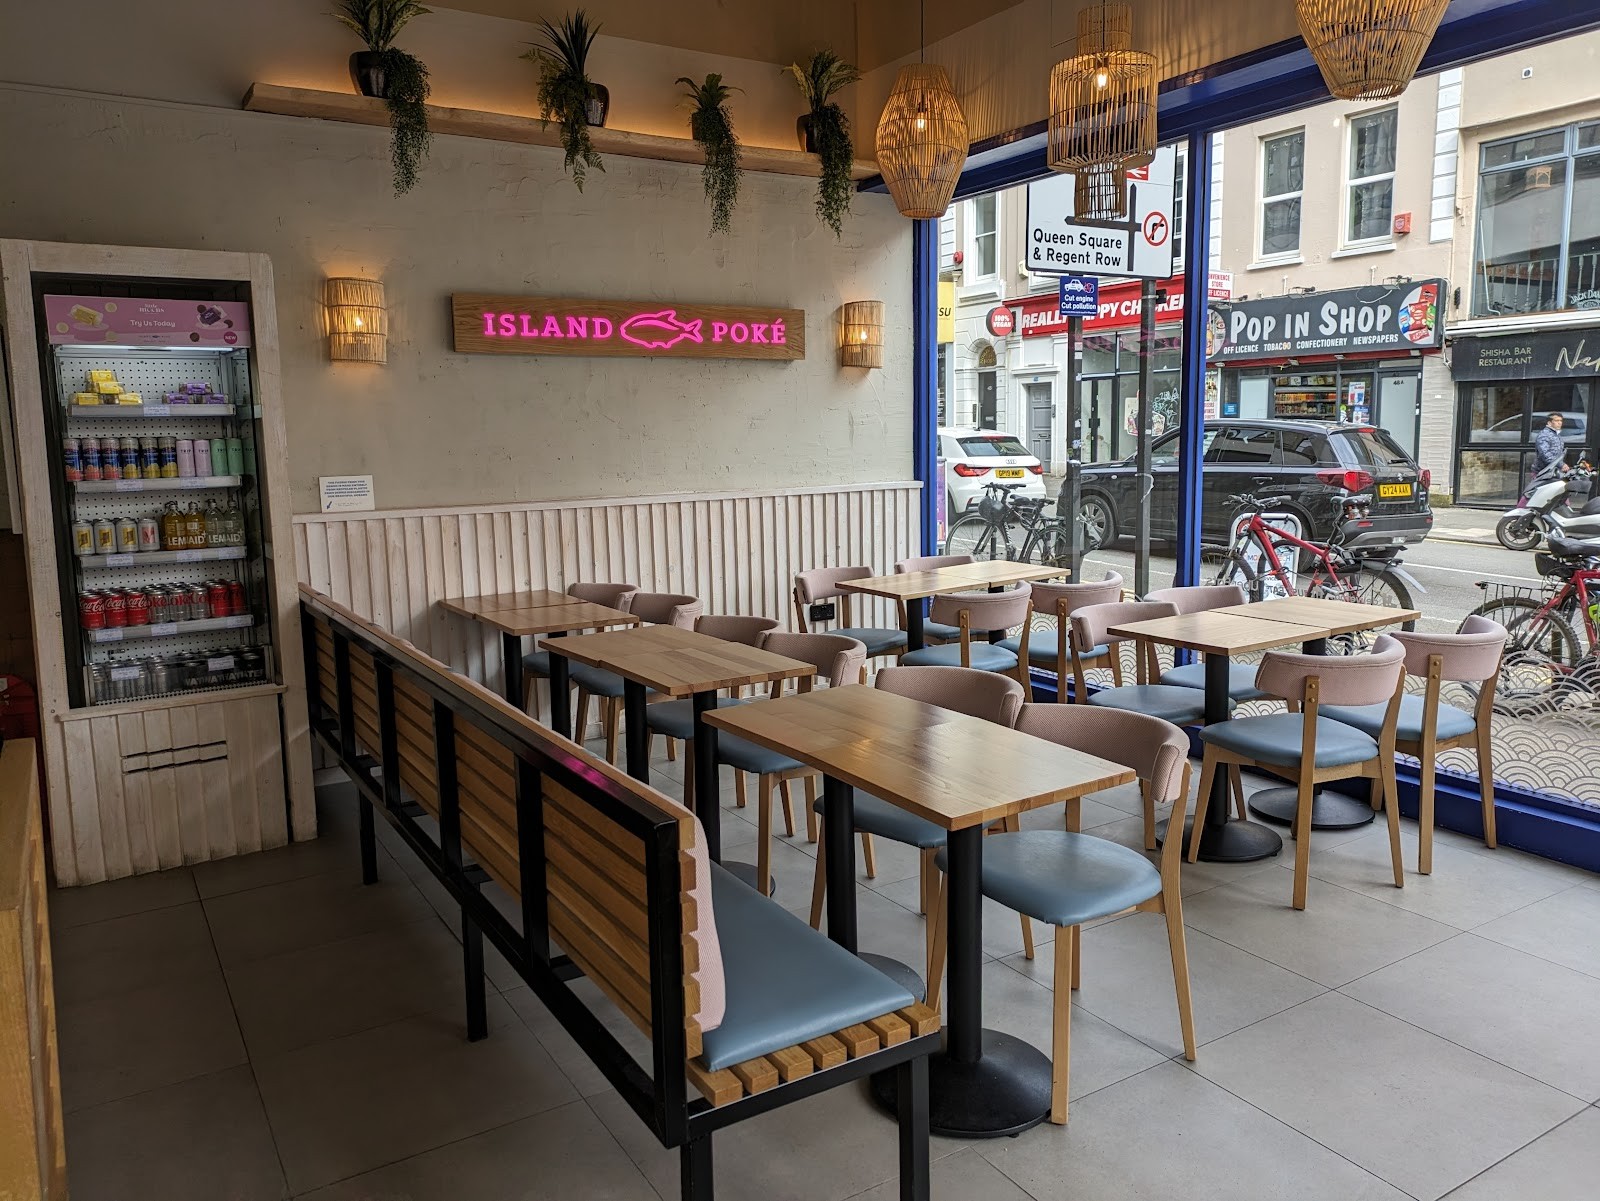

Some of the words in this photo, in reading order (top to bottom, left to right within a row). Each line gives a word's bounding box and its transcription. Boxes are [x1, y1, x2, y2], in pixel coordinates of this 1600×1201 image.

[1033, 228, 1074, 245] Queen
[1079, 232, 1122, 250] Square
[1033, 247, 1042, 261] &
[1046, 248, 1090, 265] Regent
[1095, 252, 1121, 266] Row
[1075, 295, 1093, 303] engine
[1061, 301, 1072, 309] Cut
[1072, 302, 1096, 310] pollution
[130, 320, 142, 328] Try
[154, 320, 176, 328] Today
[483, 313, 613, 339] ISLAND
[711, 318, 787, 344] POKÉ
[1223, 346, 1235, 355] OFF
[1235, 344, 1259, 353] LICENCE
[1296, 337, 1348, 349] CONFECTIONERY
[1353, 333, 1399, 345] NEWSPAPERS
[1480, 349, 1511, 358] SHISHA
[1514, 347, 1532, 355] BAR
[1478, 356, 1533, 367] RESTAURANT
